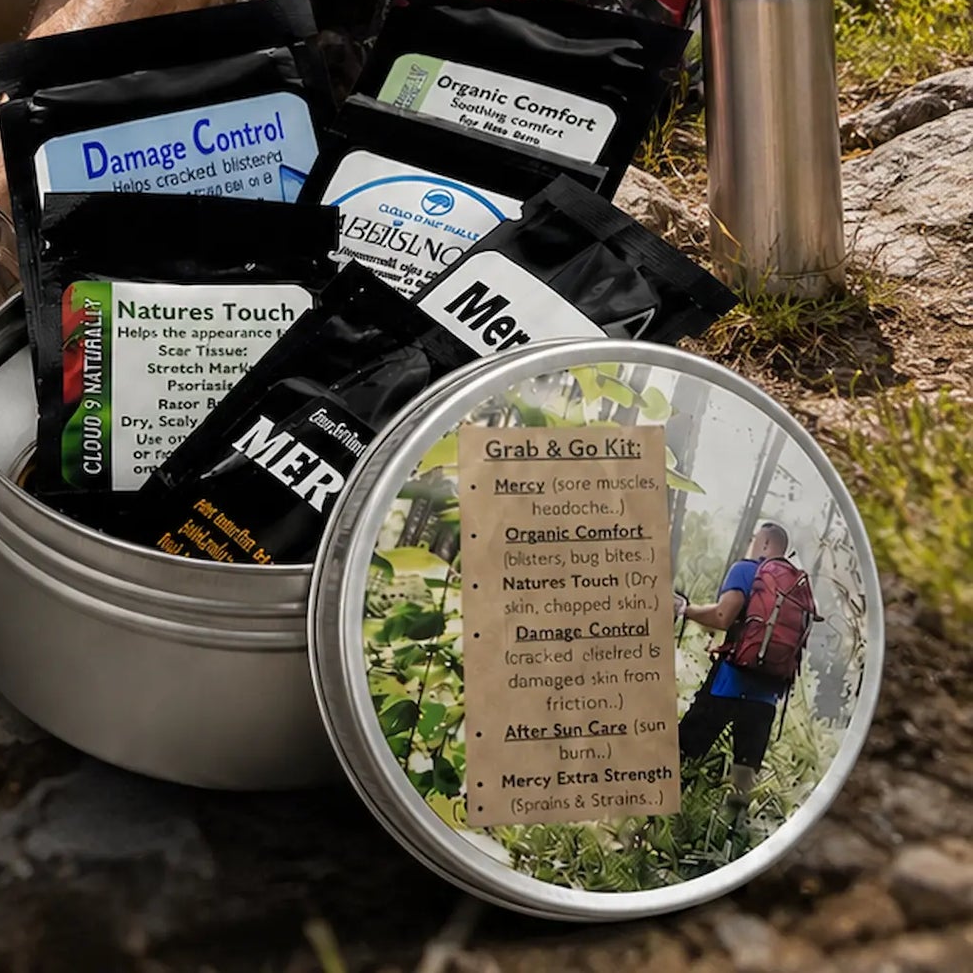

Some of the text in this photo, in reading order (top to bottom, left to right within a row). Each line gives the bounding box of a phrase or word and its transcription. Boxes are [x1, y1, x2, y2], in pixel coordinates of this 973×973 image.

[436, 75, 508, 105] Organic
[514, 94, 597, 132] Comfort
[83, 111, 285, 179] Damage Control
[156, 163, 217, 188] cracked
[117, 300, 295, 322] Natures Touch
[443, 280, 531, 352] Mer
[117, 326, 158, 341] Helps
[162, 327, 187, 339] the
[191, 328, 272, 341] appearance
[158, 344, 191, 357] Scar
[147, 362, 204, 374] Stretch
[83, 298, 102, 475] CLOUD 9 NATURALLY
[158, 399, 200, 410] Razor
[121, 415, 198, 430] Dry, Scaly
[136, 434, 163, 445] Use
[485, 437, 642, 459] Grab & Go Kit:
[133, 450, 151, 459] or
[231, 414, 346, 514] MER
[494, 474, 659, 495] Mercy (sore muscles,
[505, 524, 644, 543] Organic Comfort
[503, 550, 566, 569] (blisters,
[570, 549, 600, 567] bug
[502, 571, 658, 591] Natures Touch (Dry
[544, 596, 611, 616] chapped
[516, 618, 650, 643] Damage Control
[505, 648, 573, 665] (cracked
[508, 669, 660, 691] damaged skin from
[546, 692, 624, 712] friction..)
[505, 718, 666, 740] After Sun Care (sun
[501, 765, 673, 789] Mercy Extra Strength
[511, 794, 570, 815] (Sprains
[575, 793, 586, 808] &
